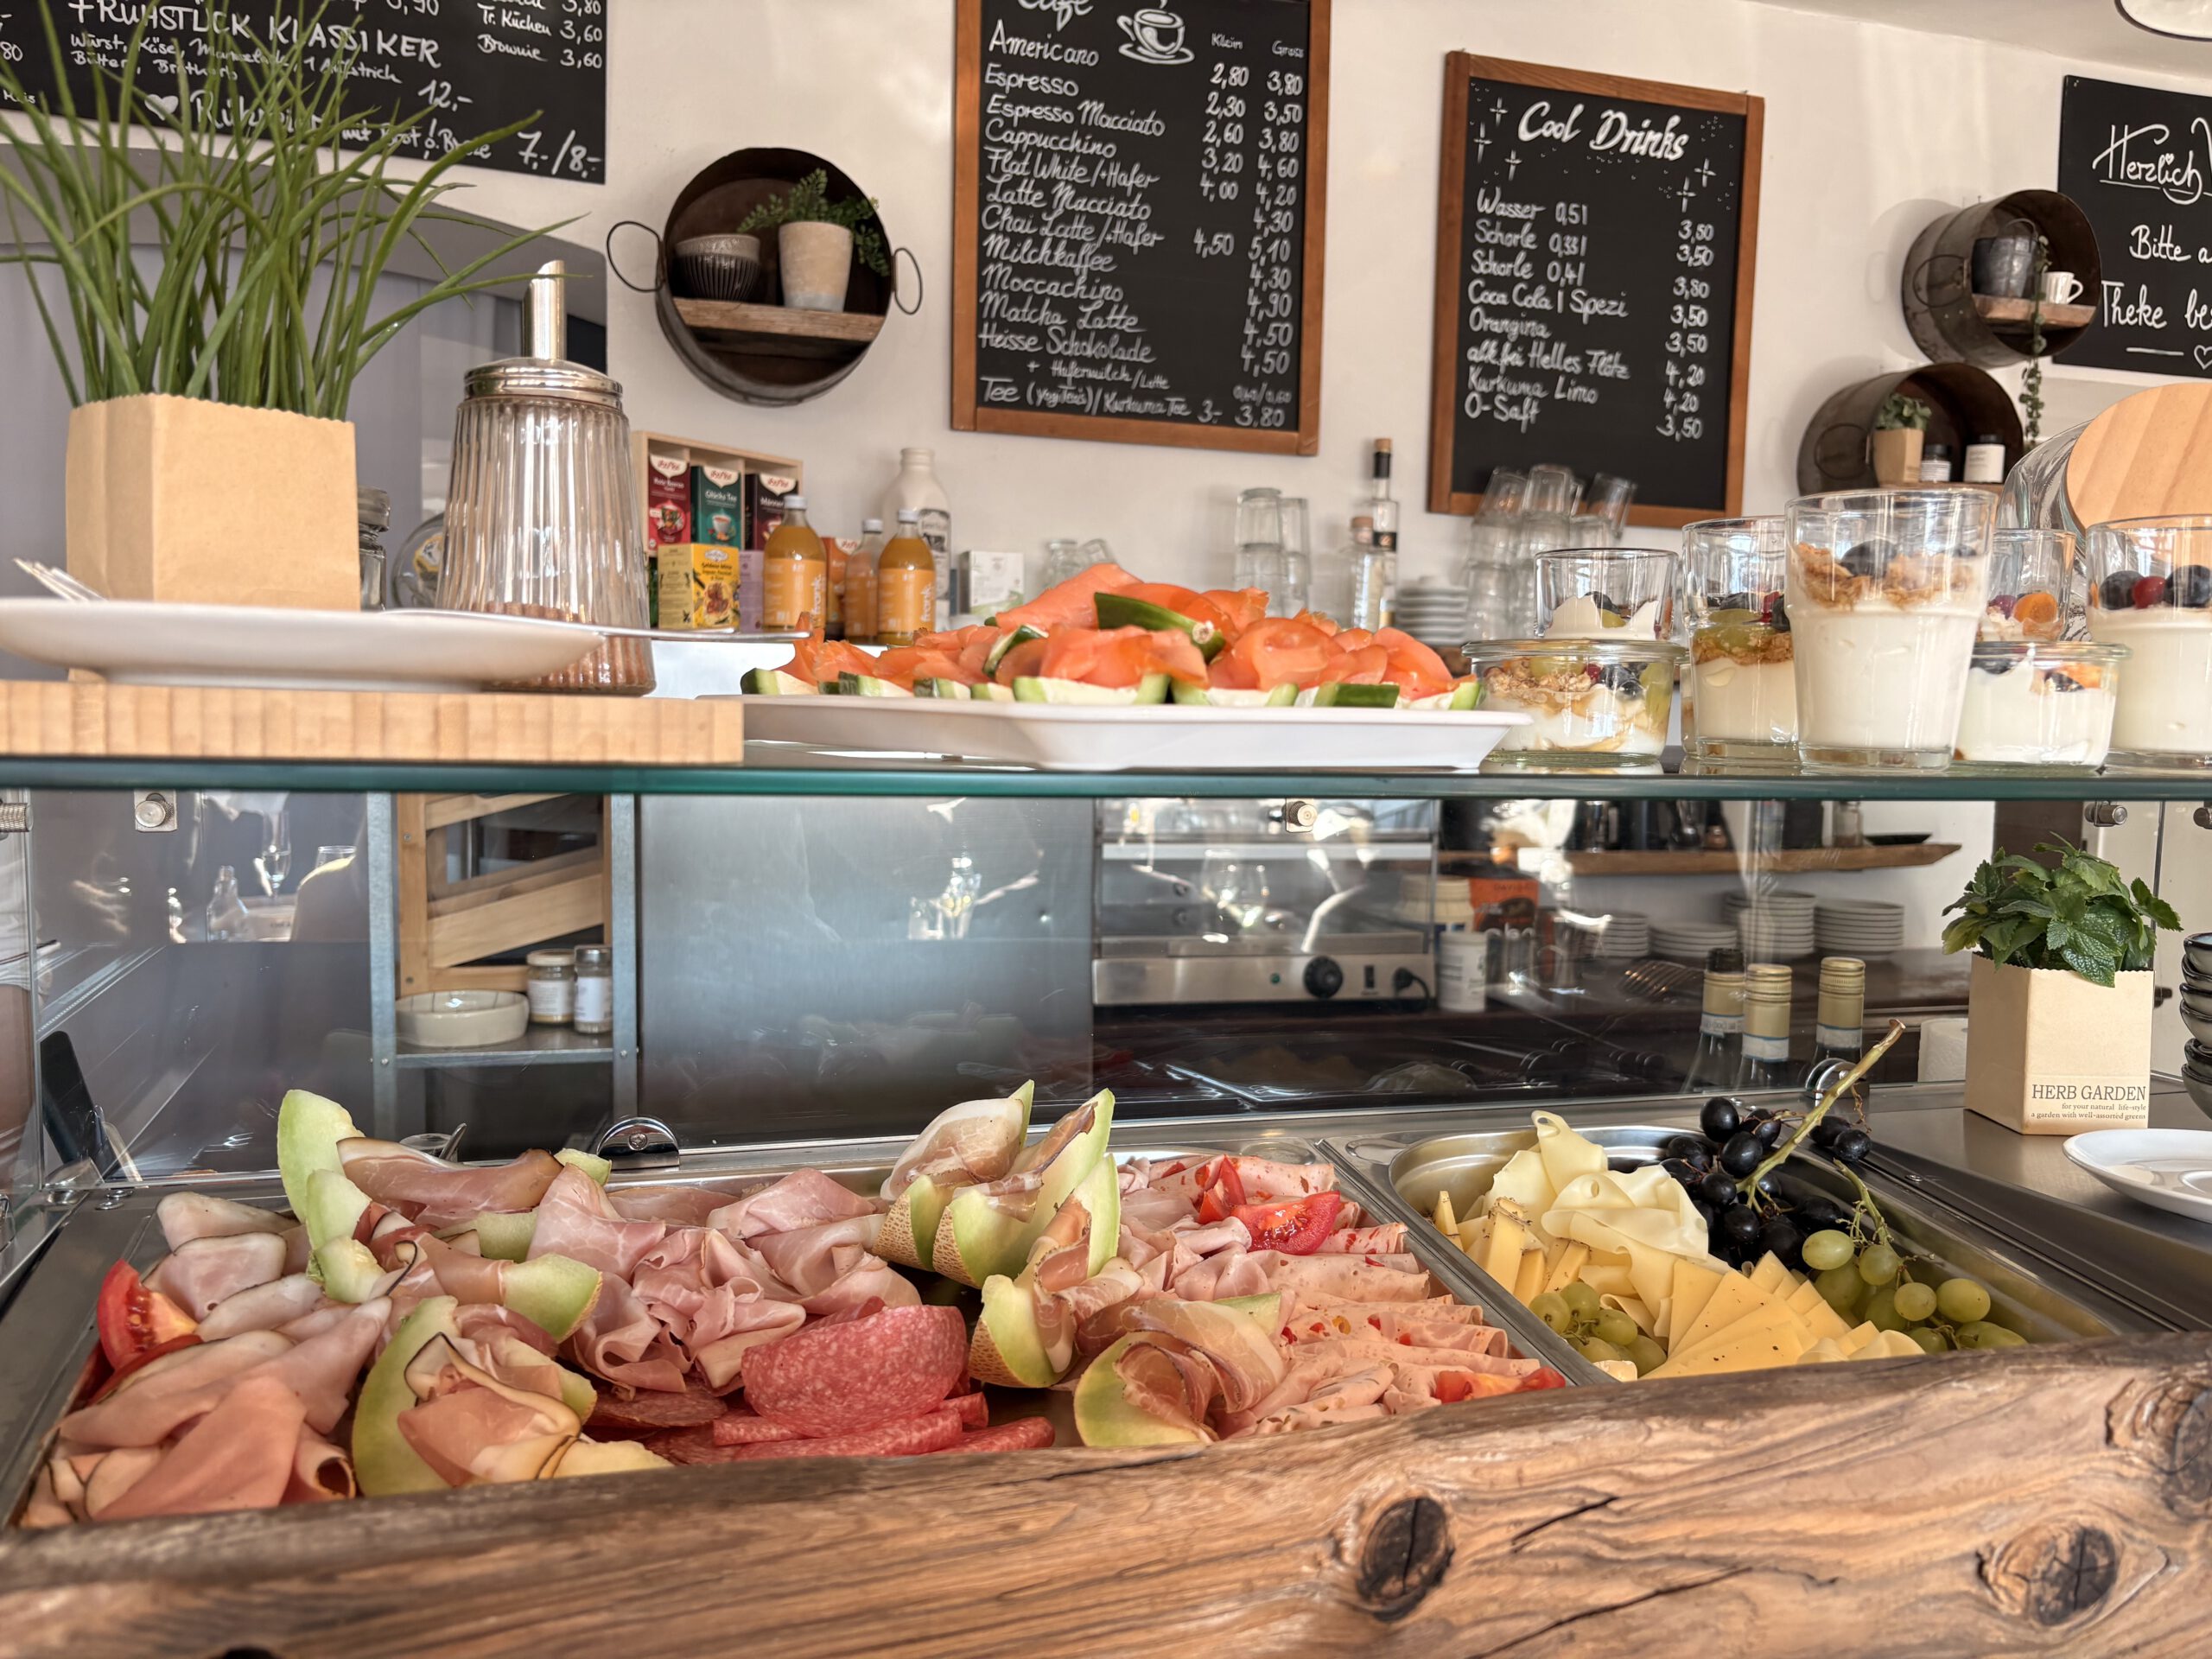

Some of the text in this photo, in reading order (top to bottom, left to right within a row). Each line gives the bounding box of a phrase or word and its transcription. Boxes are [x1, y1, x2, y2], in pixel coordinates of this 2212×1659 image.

[477, 3, 496, 25] Tr.
[560, 20, 603, 44] 3,60
[1211, 33, 1243, 50] Klein
[477, 33, 603, 68] Brownie 3,60
[988, 19, 1304, 96] Americano 2,80 3,80
[984, 61, 1303, 126] Espresso 2,30 3,50
[380, 123, 422, 148] Bot
[437, 128, 492, 159] Bre
[984, 117, 1300, 181] Cappucchino 3,20 4,60
[985, 93, 1300, 154] Espresso Macciato 2,60 3,80
[1518, 100, 1690, 162] Cool Drinks
[983, 145, 1033, 175] Flat
[1033, 149, 1091, 183] White
[1199, 172, 1239, 200] 4,00
[1255, 181, 1298, 210] 4,20
[2091, 123, 2203, 206] Herzlich
[985, 173, 1294, 237] Latte Macciato 4,30
[1476, 185, 1547, 219] Wasser
[1677, 219, 1715, 245] 3,50
[981, 203, 1039, 234] Chai
[1038, 207, 1096, 241] Latte
[1193, 228, 1235, 258] 4,50
[1248, 236, 1292, 267] 5,10
[1474, 218, 1539, 251] Schorle
[1675, 244, 1715, 268] 3,50
[2129, 224, 2192, 261] Bitte
[982, 232, 1292, 292] Milchkaffee 4,30
[1471, 247, 1535, 280] Schorle
[1673, 276, 1712, 301] 3,80
[981, 262, 1293, 321] Moccachino 4,90
[1468, 277, 1510, 305] Coca
[1512, 282, 1554, 311] Cola
[1569, 288, 1630, 325] Spezi
[1670, 304, 1709, 329] 3,50
[2101, 279, 2212, 330] Theke be
[979, 289, 1294, 348] Matcha Latte 4,50
[1469, 305, 1708, 358] Orangina 3,50
[978, 321, 1291, 378] Heisse Schokolade 4,50
[1528, 339, 1582, 375] Helles
[1665, 359, 1707, 389] 4,20
[980, 376, 1020, 403] Tee
[1234, 404, 1286, 429] 3,80
[1464, 391, 1704, 442] O-Saft 3,50
[1467, 365, 1700, 416] Kurkuma Limo 4,20
[2031, 1084, 2146, 1101] HERB GARDEN
[2037, 1111, 2061, 1120] garden
[2062, 1110, 2077, 1119] with
[2078, 1111, 2124, 1121] well-assorted
[2073, 1104, 2088, 1113] your
[2090, 1103, 2114, 1111] natural
[2118, 1103, 2146, 1112] life-style
